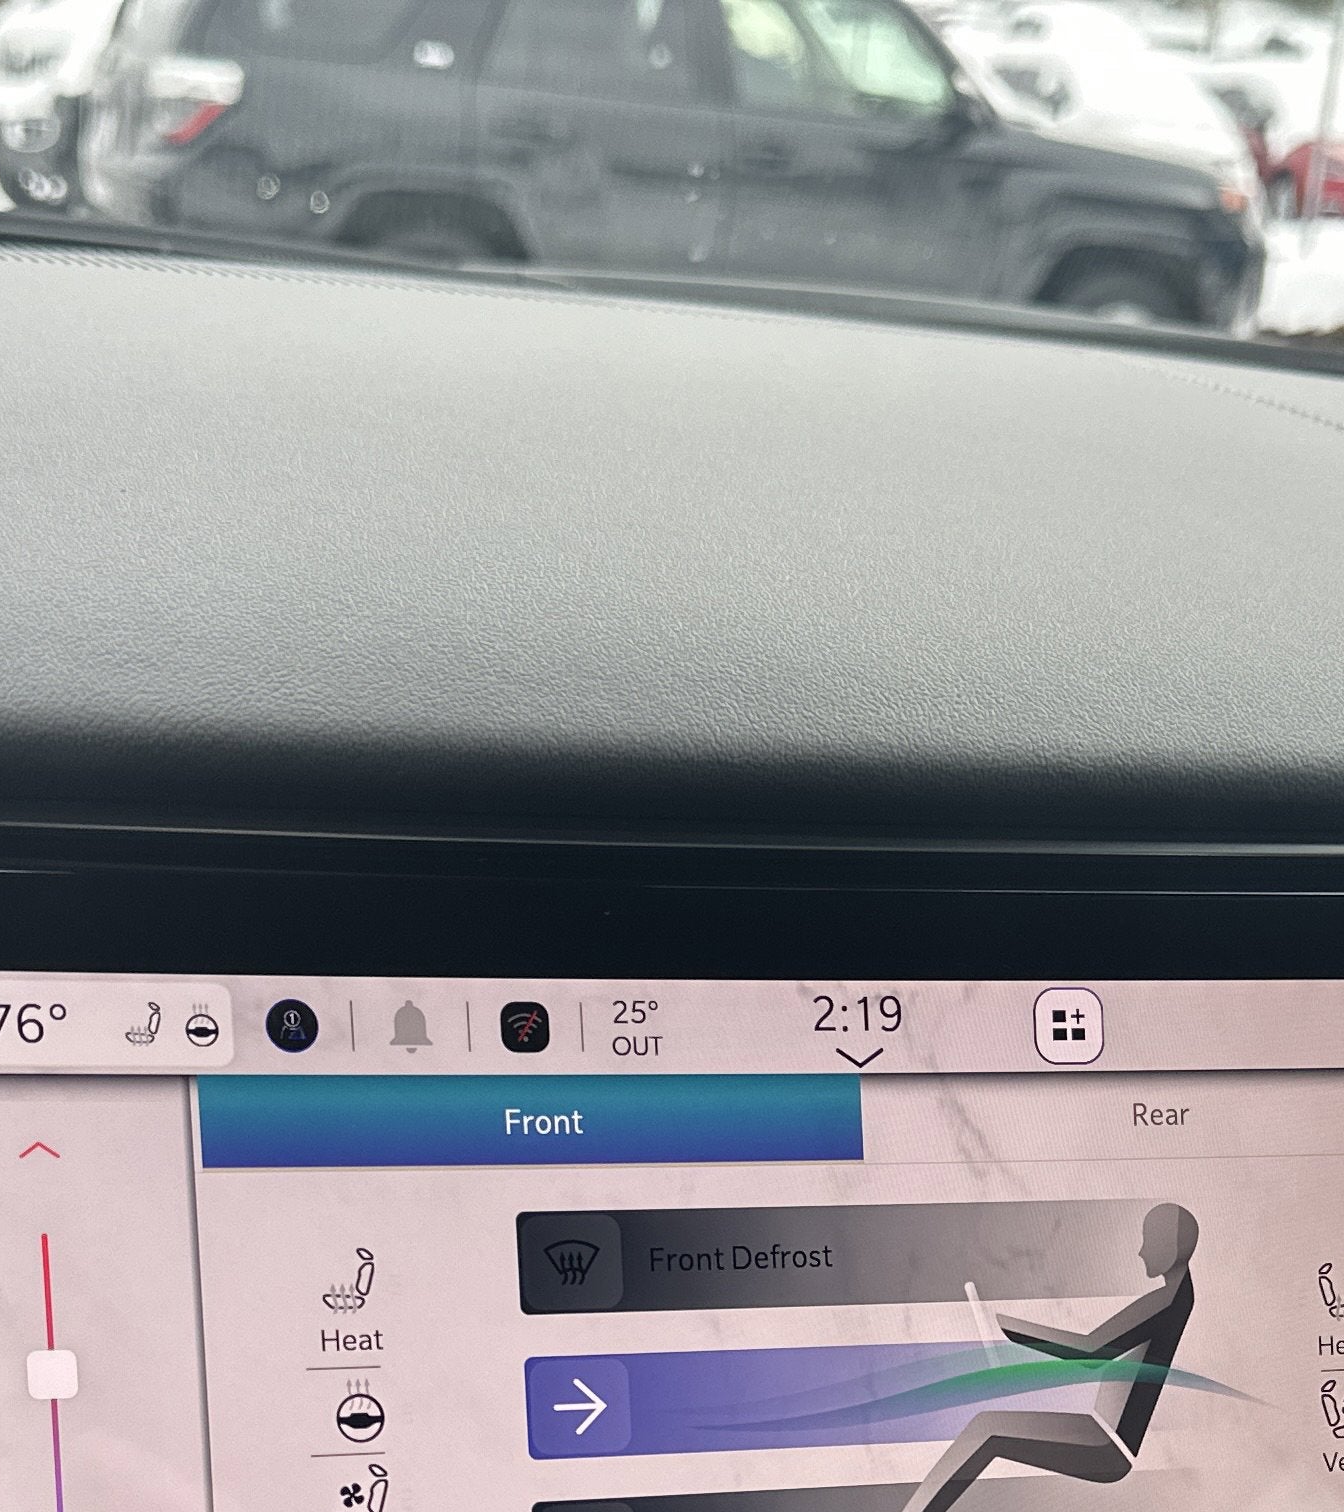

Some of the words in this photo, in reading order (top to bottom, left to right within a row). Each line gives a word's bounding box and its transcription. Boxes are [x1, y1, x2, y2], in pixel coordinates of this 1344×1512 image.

[613, 1001, 658, 1023] 25°
[814, 996, 901, 1032] 2:19
[613, 1036, 663, 1055] OUT
[506, 1109, 583, 1134] Front
[1133, 1103, 1189, 1126] Rear
[650, 1248, 724, 1271] Front
[733, 1244, 832, 1269] Defrost
[321, 1330, 383, 1351] Heat
